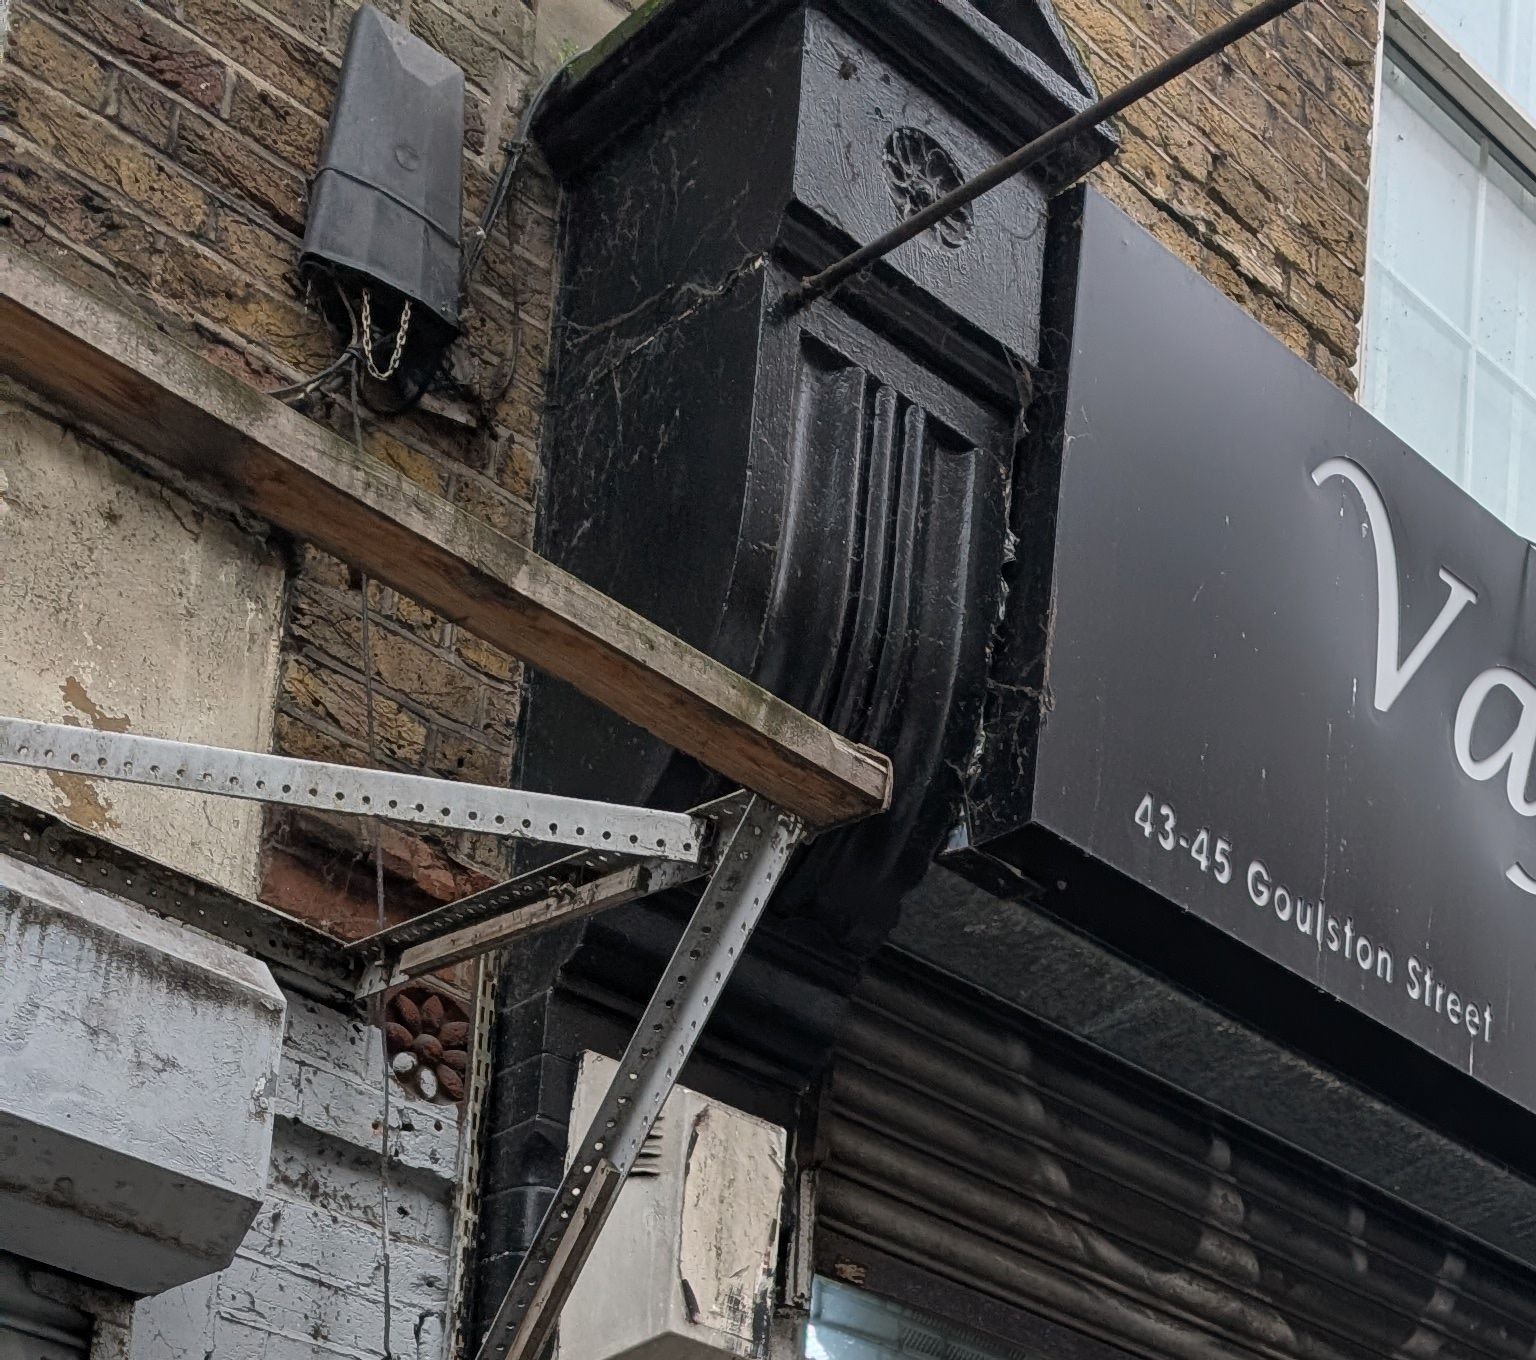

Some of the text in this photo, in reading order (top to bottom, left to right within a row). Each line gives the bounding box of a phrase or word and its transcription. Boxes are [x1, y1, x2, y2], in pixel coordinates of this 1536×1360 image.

[1134, 791, 1493, 1043] 43-45 Goulston Street
